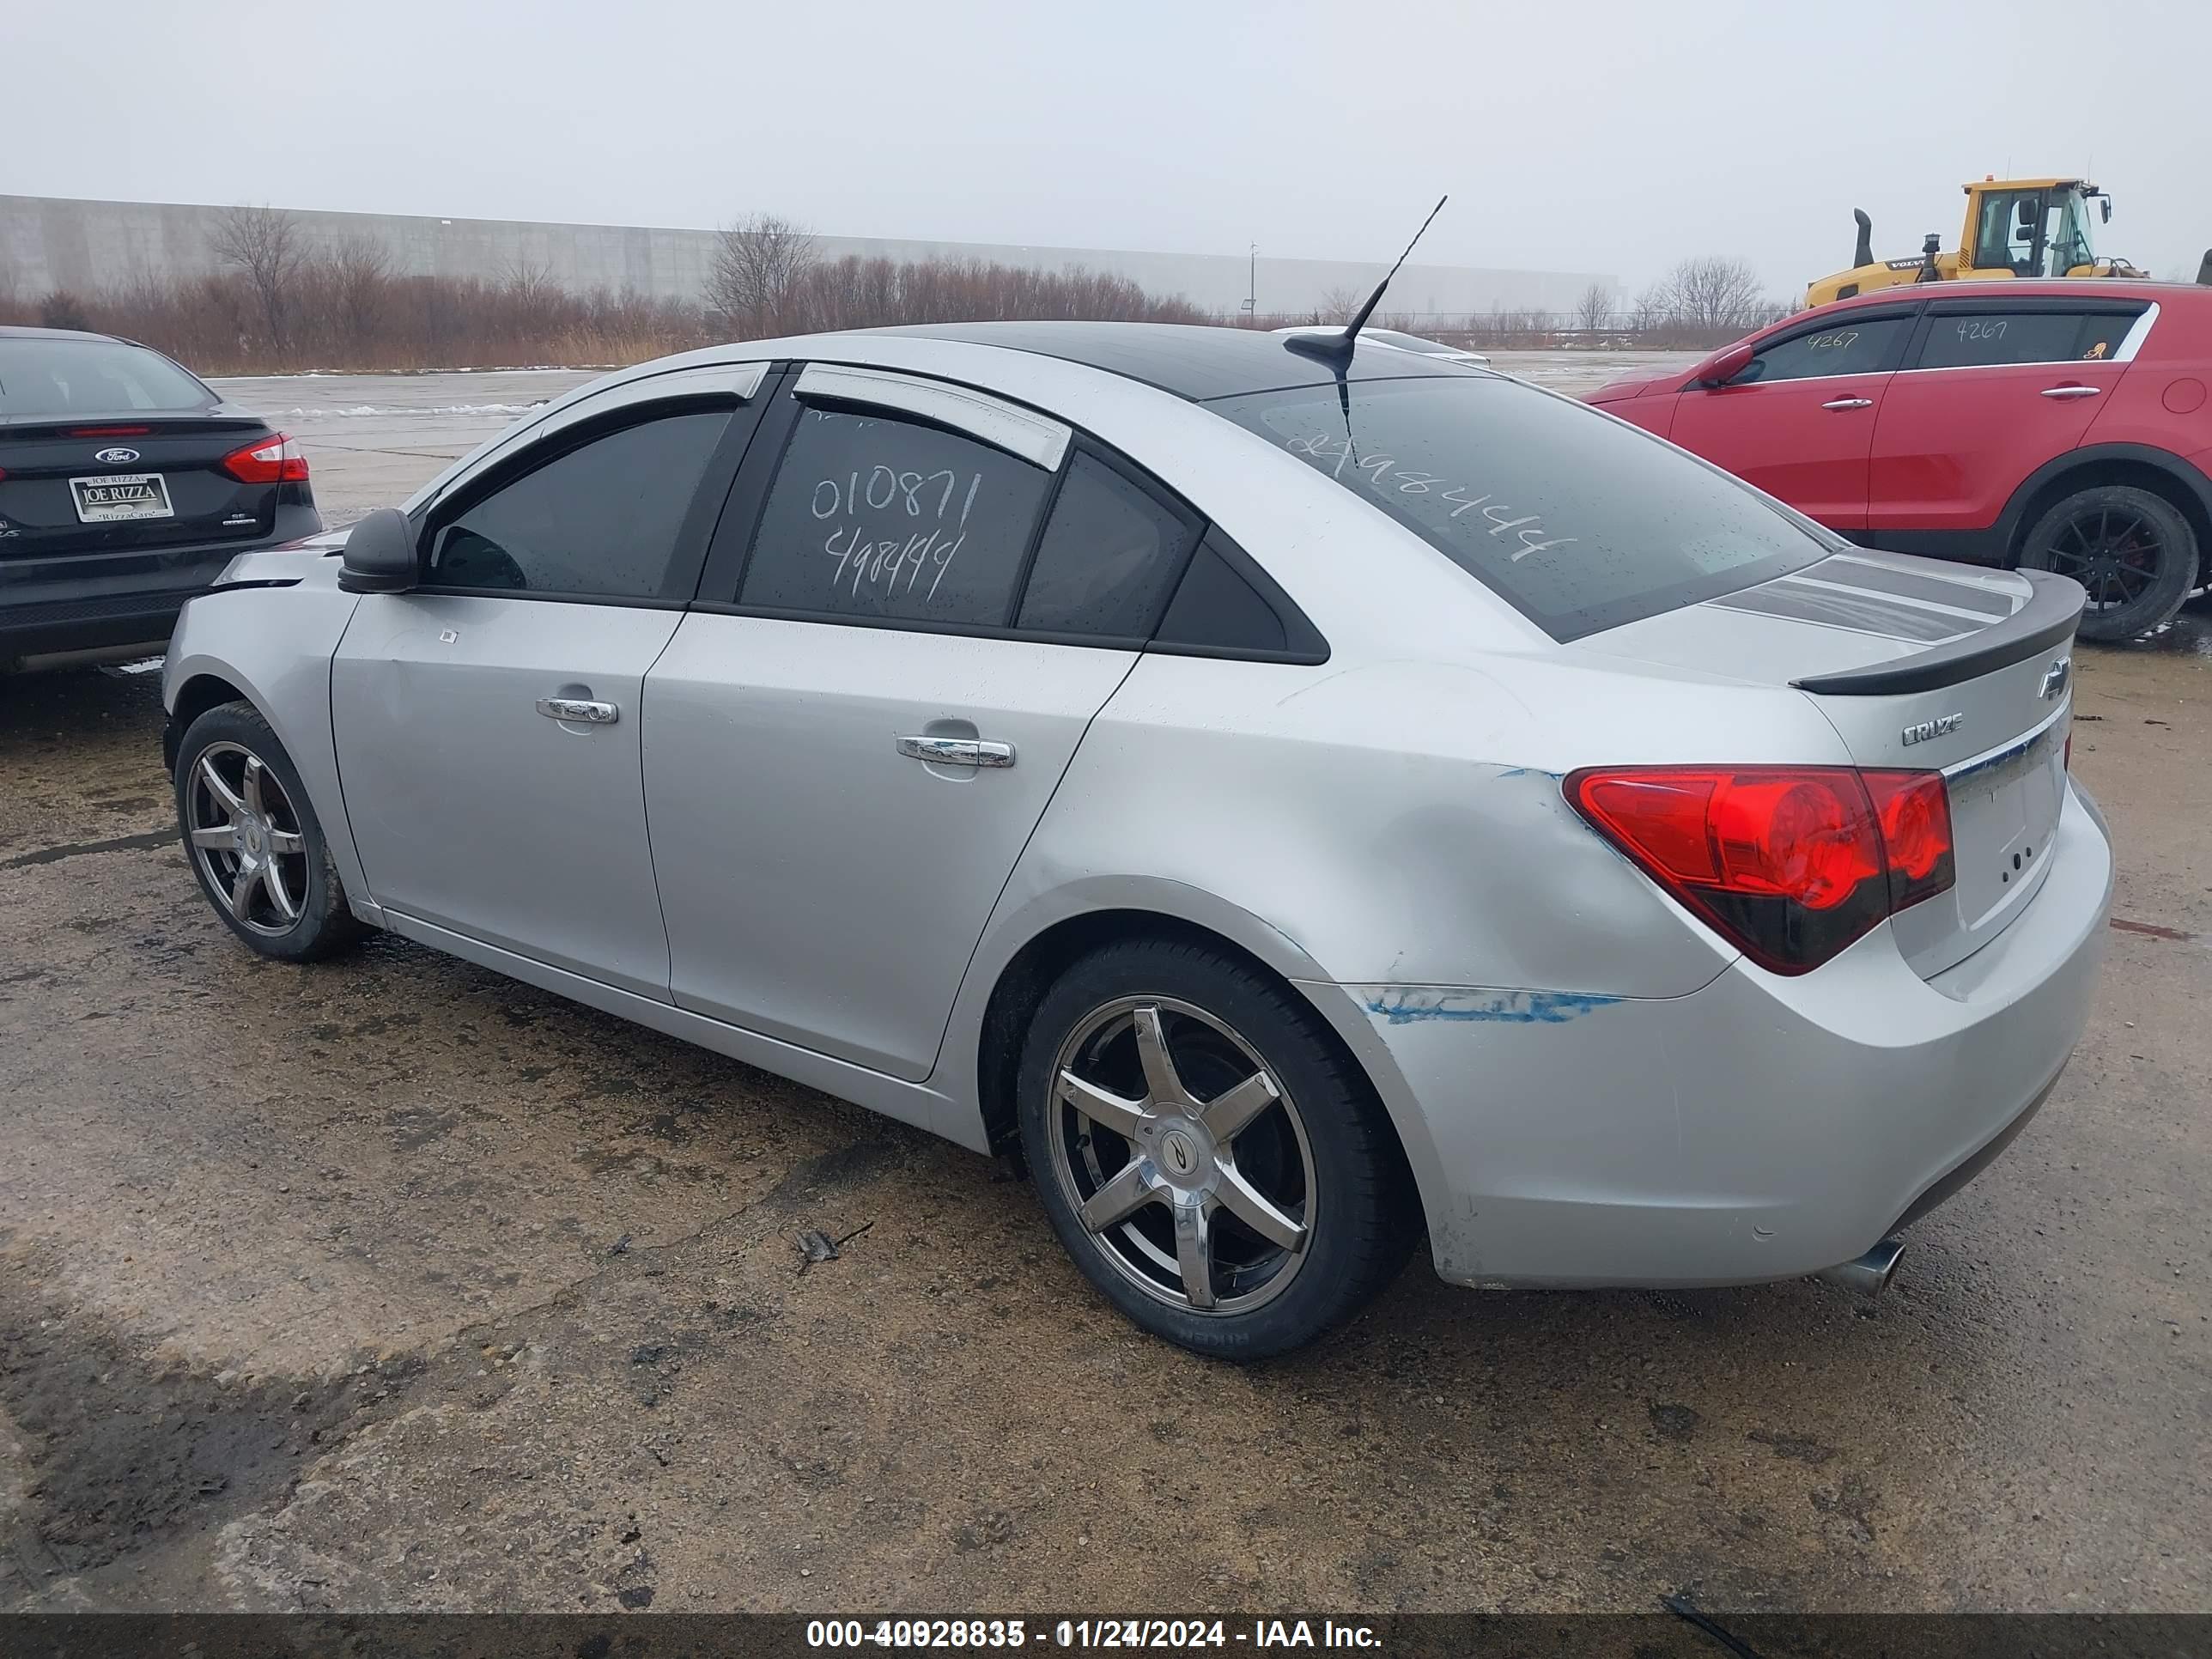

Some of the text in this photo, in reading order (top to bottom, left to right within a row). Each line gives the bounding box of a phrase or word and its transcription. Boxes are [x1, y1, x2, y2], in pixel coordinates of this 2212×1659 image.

[1808, 331, 1858, 350] 4267
[1957, 320, 2008, 343] 4267
[106, 451, 131, 461] Ford
[92, 477, 108, 486] JOE
[82, 485, 156, 505] JOE RIZZA
[811, 465, 982, 533] 010871
[1903, 712, 1964, 746] CRUZE
